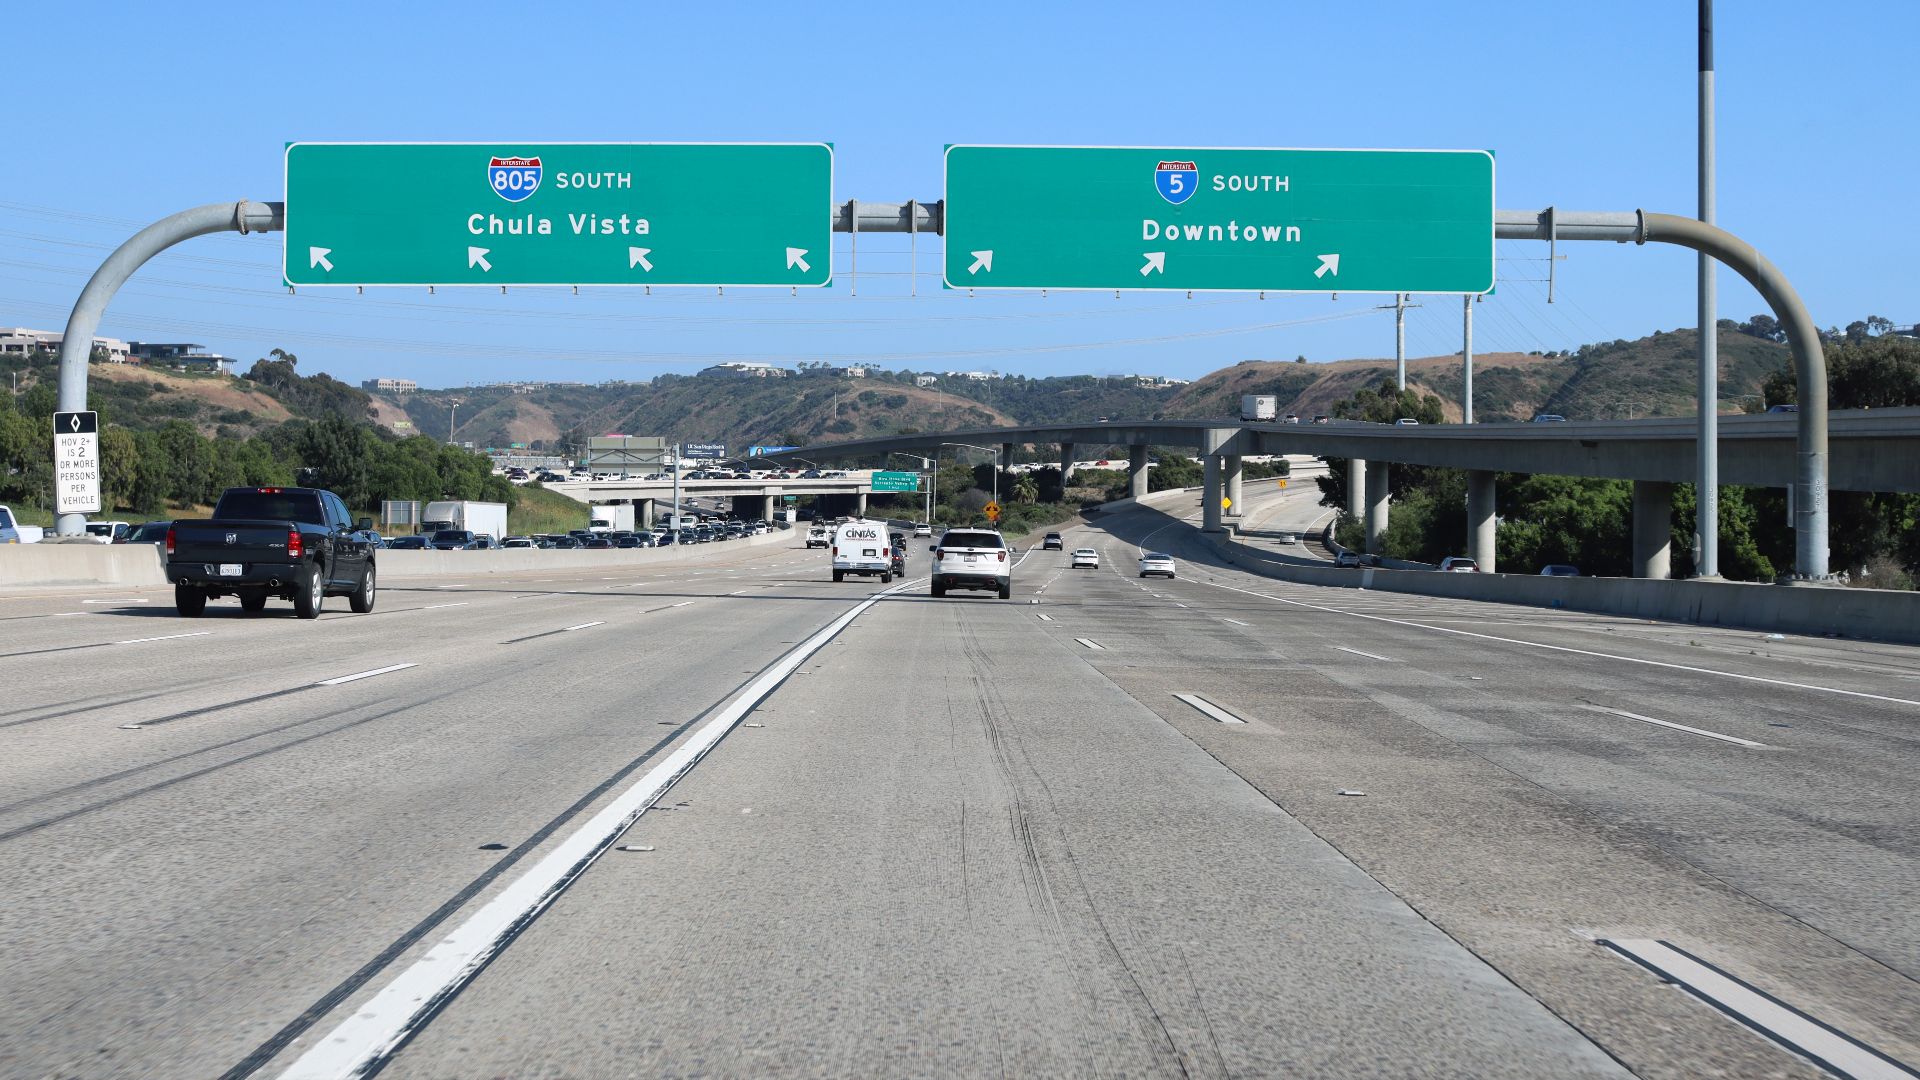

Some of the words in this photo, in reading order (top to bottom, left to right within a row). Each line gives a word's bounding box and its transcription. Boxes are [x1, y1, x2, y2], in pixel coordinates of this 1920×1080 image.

[494, 170, 537, 191] 805
[556, 172, 632, 189] SOUTH
[1170, 174, 1184, 194] 5
[1212, 175, 1289, 192] SOUTH
[468, 214, 552, 236] Chula
[568, 214, 650, 236] Vista
[1142, 219, 1301, 242] Downtown
[61, 438, 77, 446] HOV
[81, 437, 90, 446] 2+
[67, 449, 75, 457] IS
[78, 447, 86, 458] 2
[60, 461, 71, 469] OR
[73, 459, 95, 468] MORE
[60, 472, 95, 481] PERSONS
[71, 484, 86, 493] PER
[62, 495, 95, 505] VEHICLE
[845, 528, 877, 538] CINTAS
